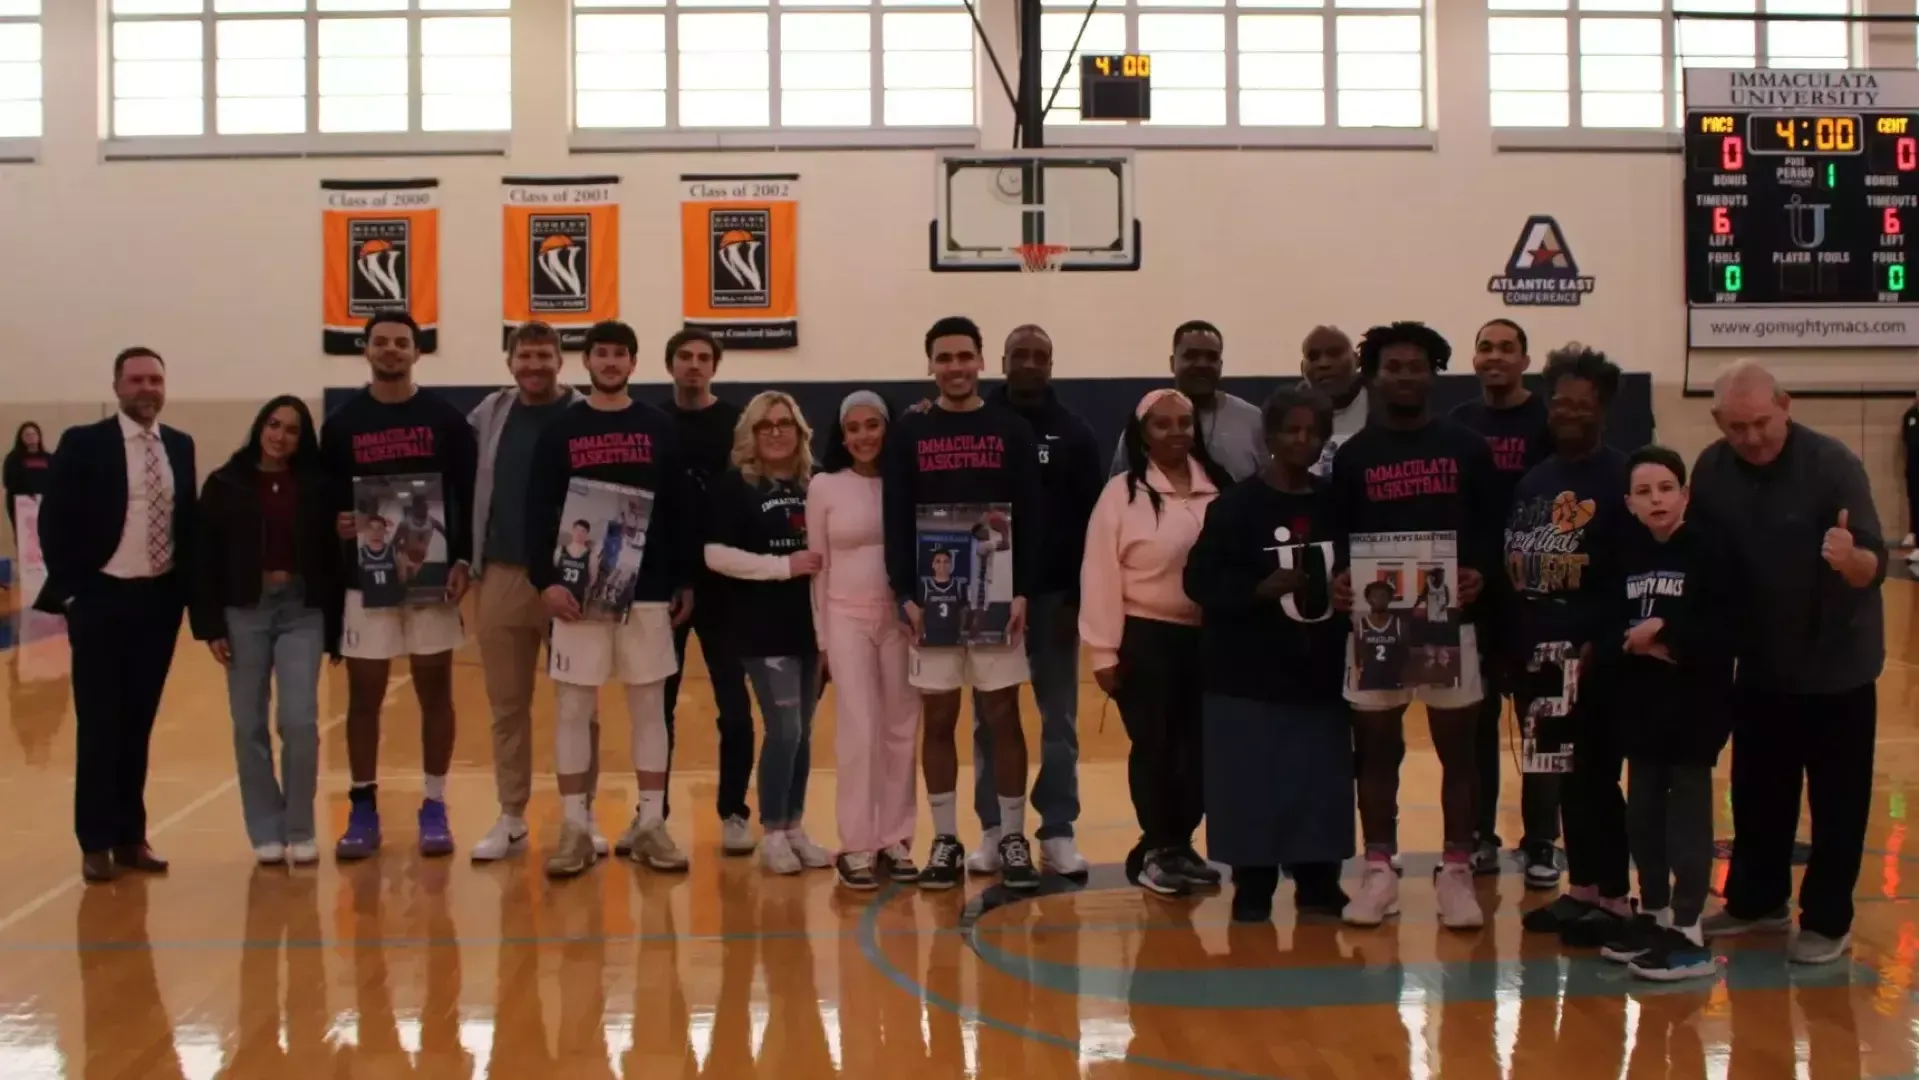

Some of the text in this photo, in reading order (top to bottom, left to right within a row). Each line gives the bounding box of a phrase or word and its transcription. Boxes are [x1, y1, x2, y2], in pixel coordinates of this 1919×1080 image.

[1730, 72, 1879, 89] IMMACULATA
[1731, 90, 1880, 106] UNIVERSITY
[1775, 117, 1854, 150] 4:00
[1722, 136, 1743, 170] 0
[1896, 137, 1917, 171] 0
[1713, 174, 1748, 187] BONUS
[1776, 166, 1814, 179] PERIOD
[1826, 163, 1836, 189] 1
[1864, 174, 1899, 187] BONUS
[329, 192, 431, 207] Class of 2000
[509, 188, 608, 202] Class of 2001
[689, 184, 789, 198] Class of 2002
[1696, 194, 1748, 207] TIMEOUTS
[1866, 194, 1918, 208] TIMEOUTS
[1712, 206, 1732, 235] 6
[1883, 206, 1901, 235] 6
[1708, 234, 1735, 247] LEFT
[1880, 234, 1904, 247] LEFT
[1708, 251, 1740, 263] FOULS
[1772, 251, 1850, 263] PLAYER FOULS
[1872, 251, 1905, 263] FOULS
[1491, 278, 1592, 290] ATLANTIC EAST
[1724, 264, 1742, 292] 0
[1887, 264, 1906, 292] 0
[1506, 292, 1578, 303] CONFERENCE
[1710, 316, 1906, 337] www.gomightymacs.com
[567, 432, 653, 454] IMMACULATA
[916, 434, 1005, 454] IMMACULATA
[571, 446, 653, 469] BASKETBALL
[918, 451, 1003, 473] BASKETBALL
[1364, 457, 1459, 484] IMMACULATA
[1367, 475, 1458, 503] BASKETBALL
[373, 569, 387, 585] 11
[562, 567, 579, 584] 33
[1656, 577, 1684, 598] MACS
[939, 602, 949, 619] 3
[1375, 644, 1387, 662] 2
[1522, 640, 1580, 773] 2
